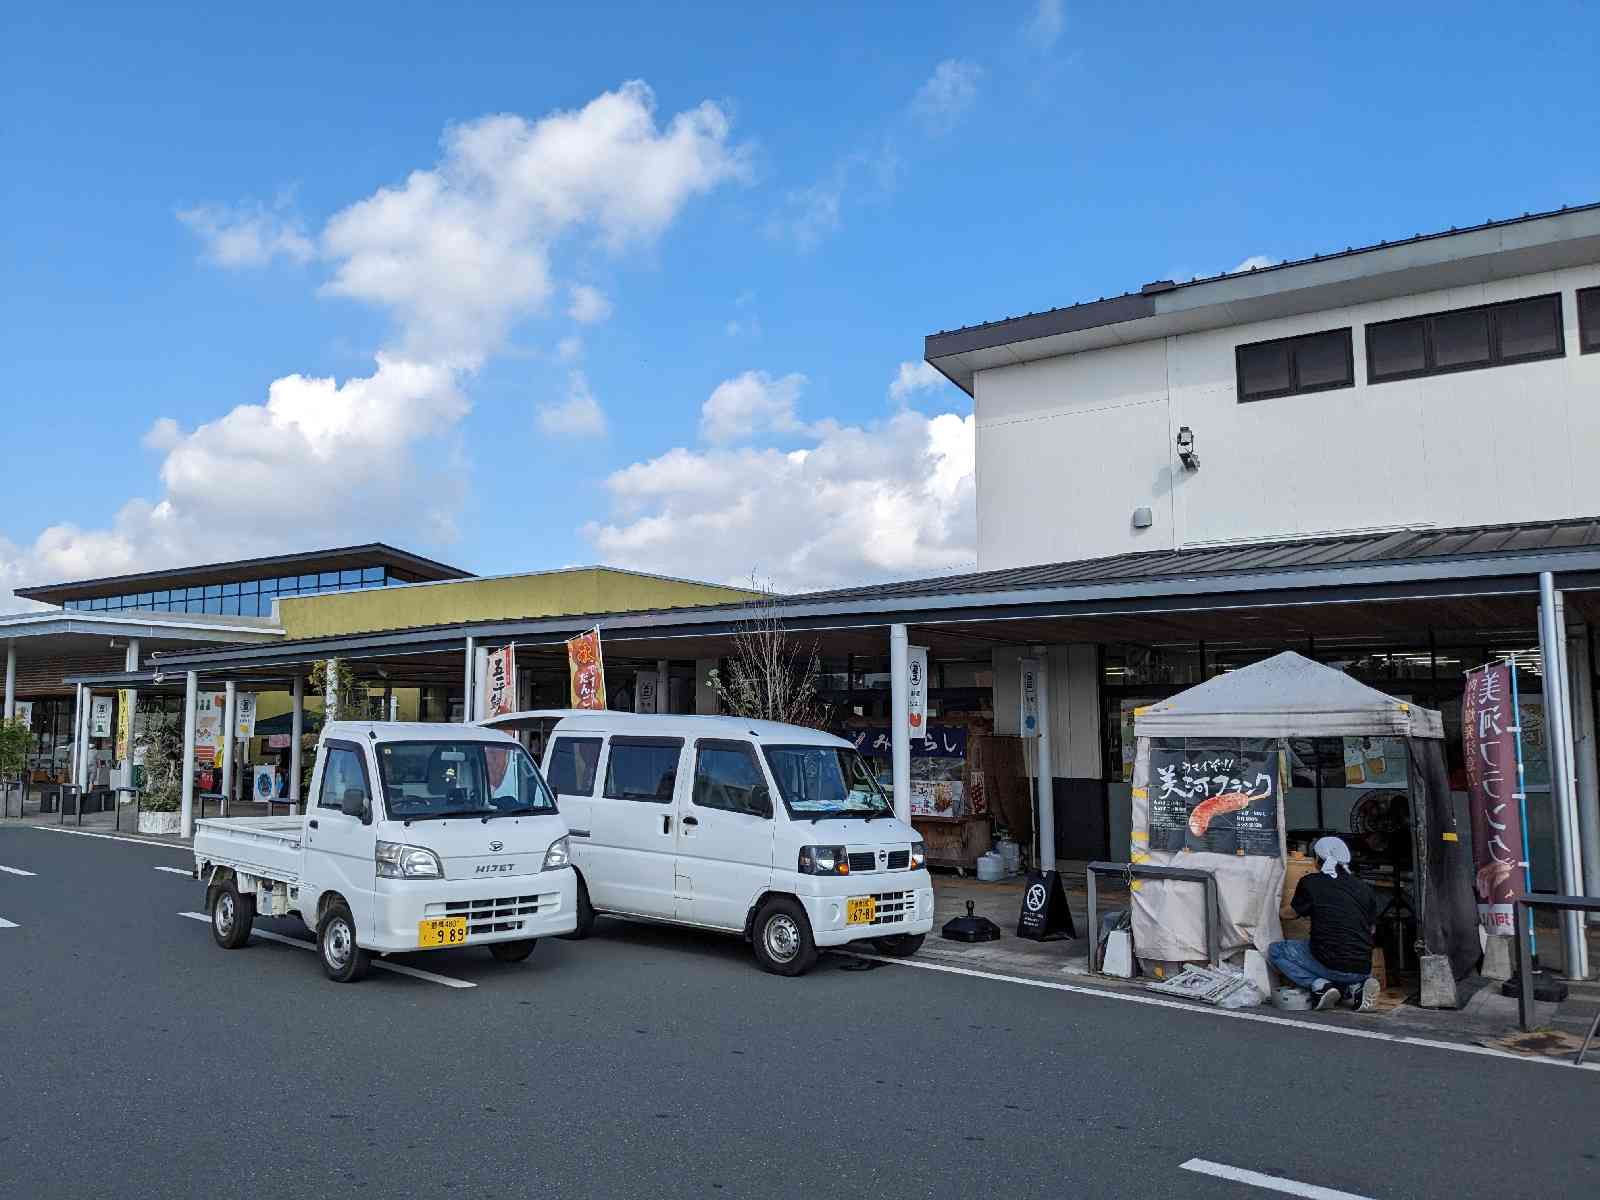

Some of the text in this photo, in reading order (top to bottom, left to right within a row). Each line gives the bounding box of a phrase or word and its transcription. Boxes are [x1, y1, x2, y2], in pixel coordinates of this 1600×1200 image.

[872, 732, 957, 753] みらし
[1157, 764, 1272, 799] 美河フランク
[475, 863, 515, 873] HIJET
